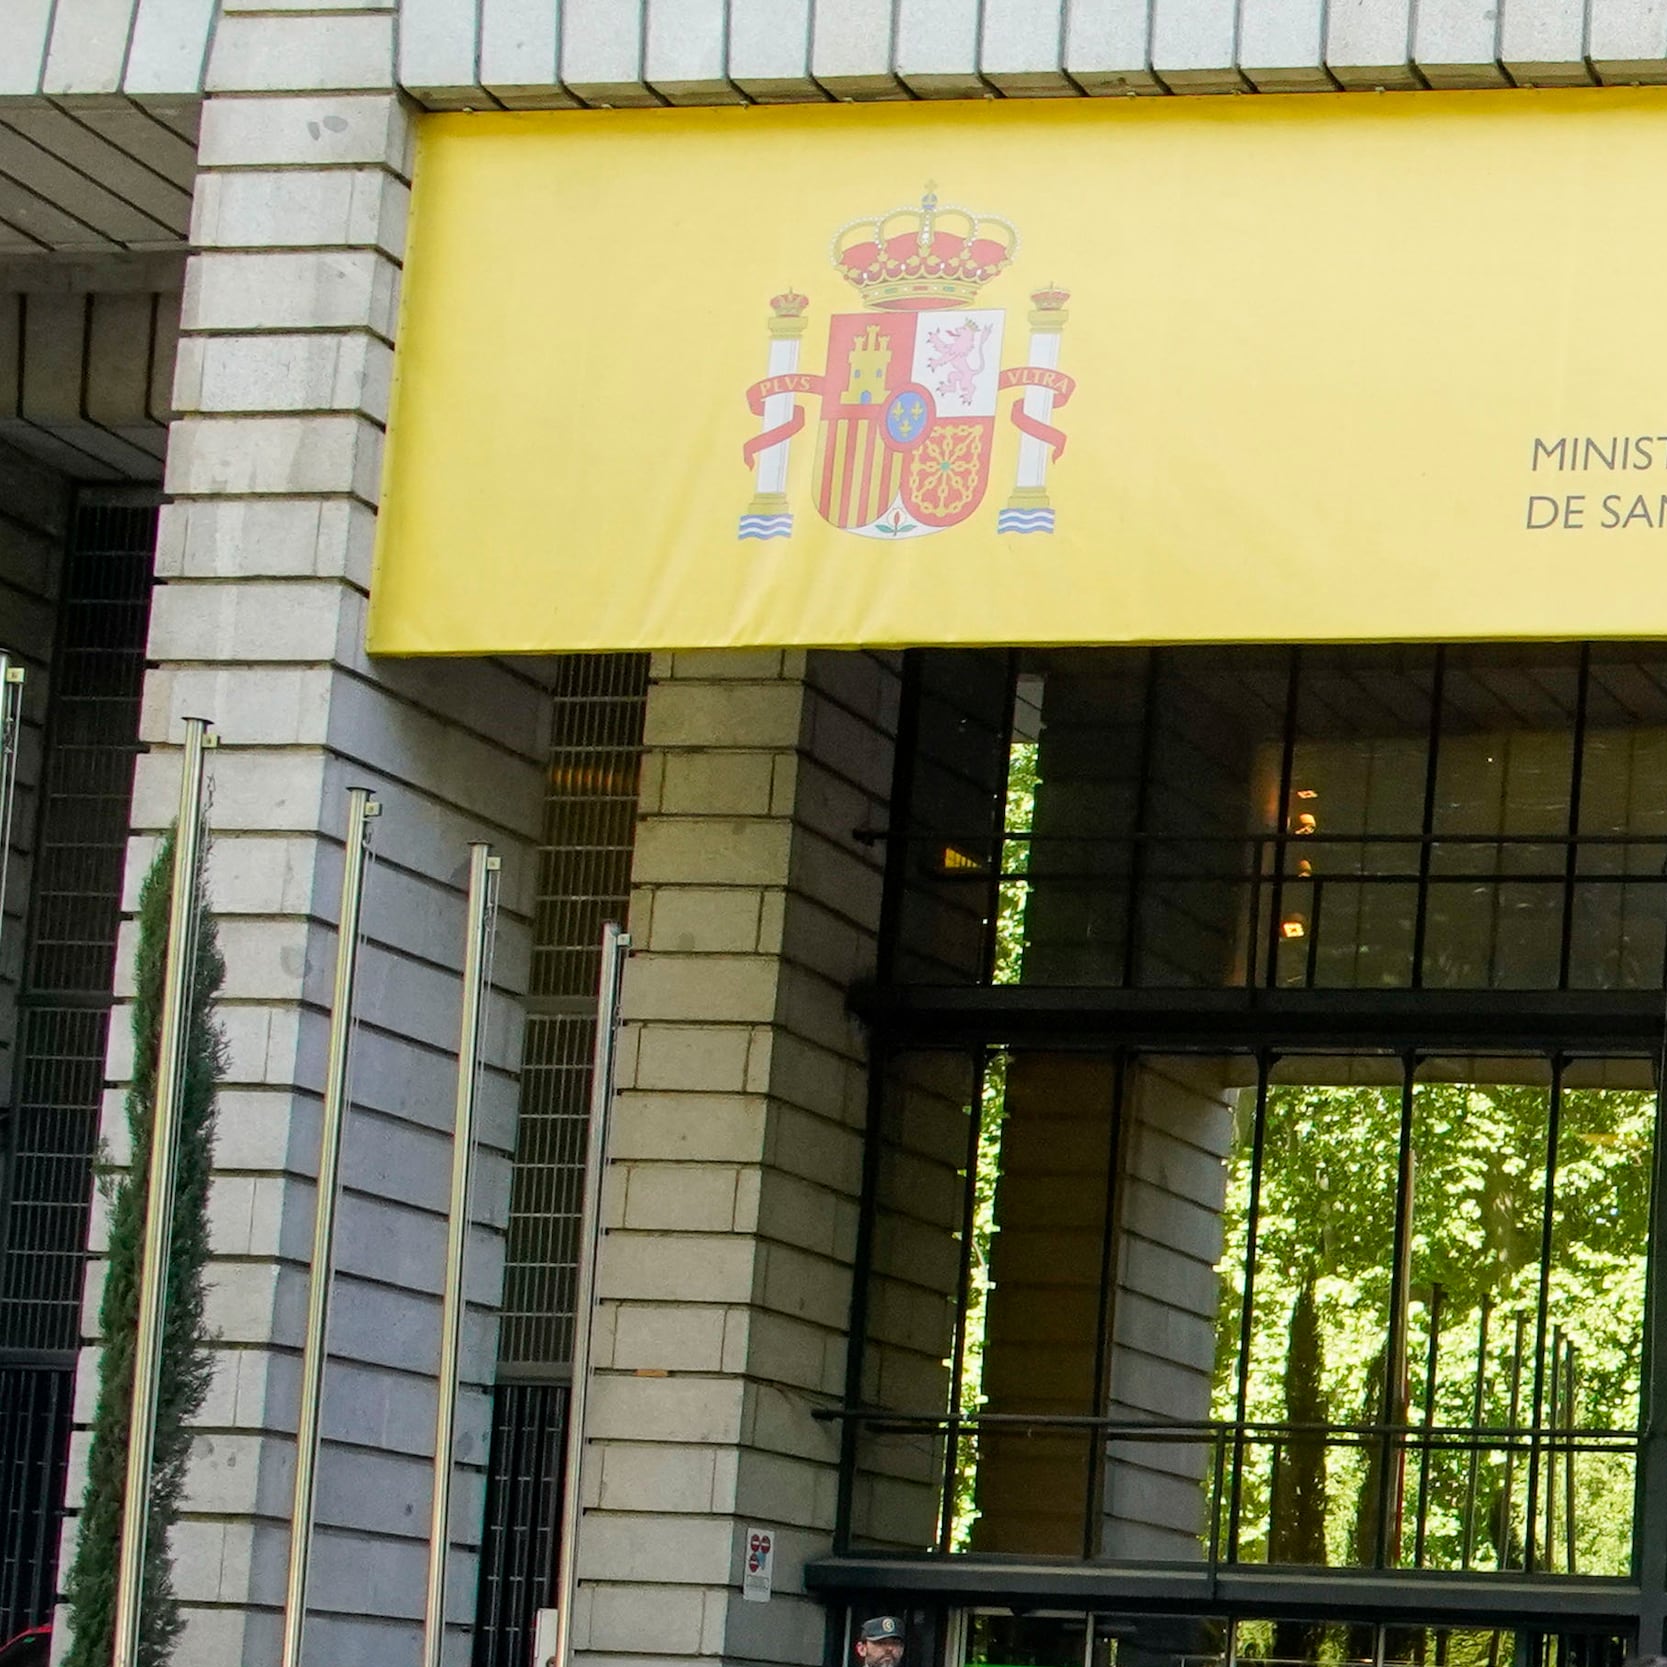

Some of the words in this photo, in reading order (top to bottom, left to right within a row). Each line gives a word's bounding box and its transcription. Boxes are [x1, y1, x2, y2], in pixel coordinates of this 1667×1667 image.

[759, 377, 811, 397] PLVS
[1007, 369, 1070, 394] VLTRA
[1526, 496, 1586, 529] DE
